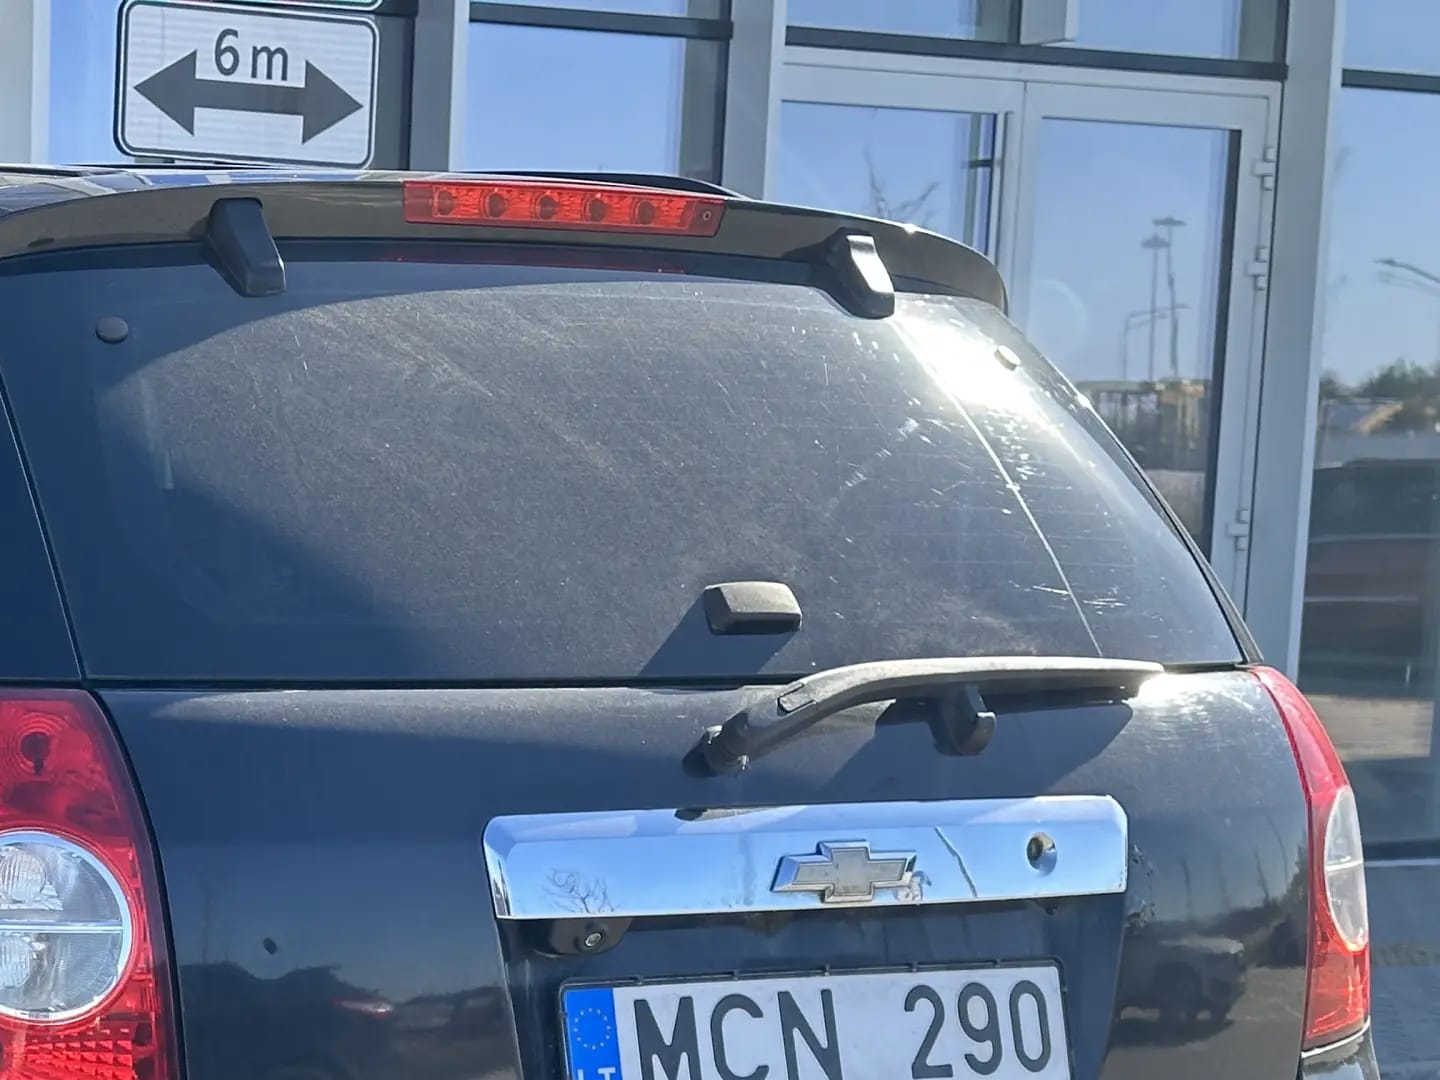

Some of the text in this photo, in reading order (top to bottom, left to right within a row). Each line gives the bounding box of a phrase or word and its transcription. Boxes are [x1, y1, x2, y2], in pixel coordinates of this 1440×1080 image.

[214, 28, 289, 82] 6 m
[903, 979, 1053, 1080] 290
